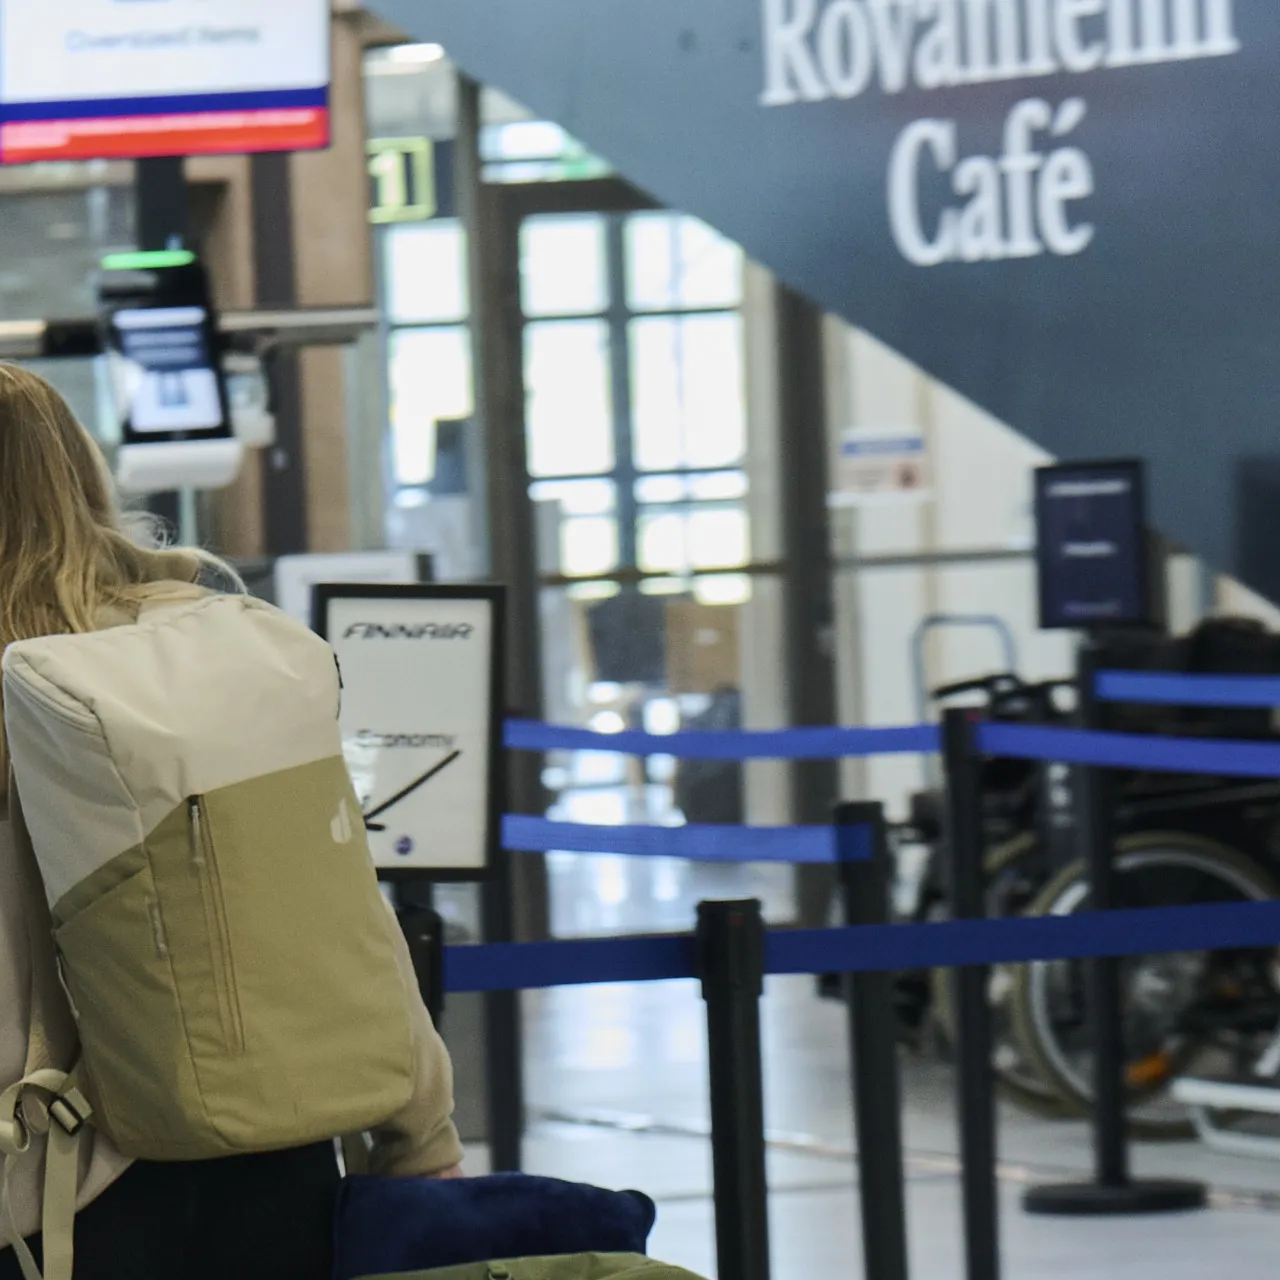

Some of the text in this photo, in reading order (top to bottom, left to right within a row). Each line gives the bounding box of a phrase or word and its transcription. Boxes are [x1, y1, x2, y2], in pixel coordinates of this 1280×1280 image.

[887, 98, 1095, 266] Café
[342, 621, 475, 640] FINNAIR
[356, 728, 460, 749] Economy
